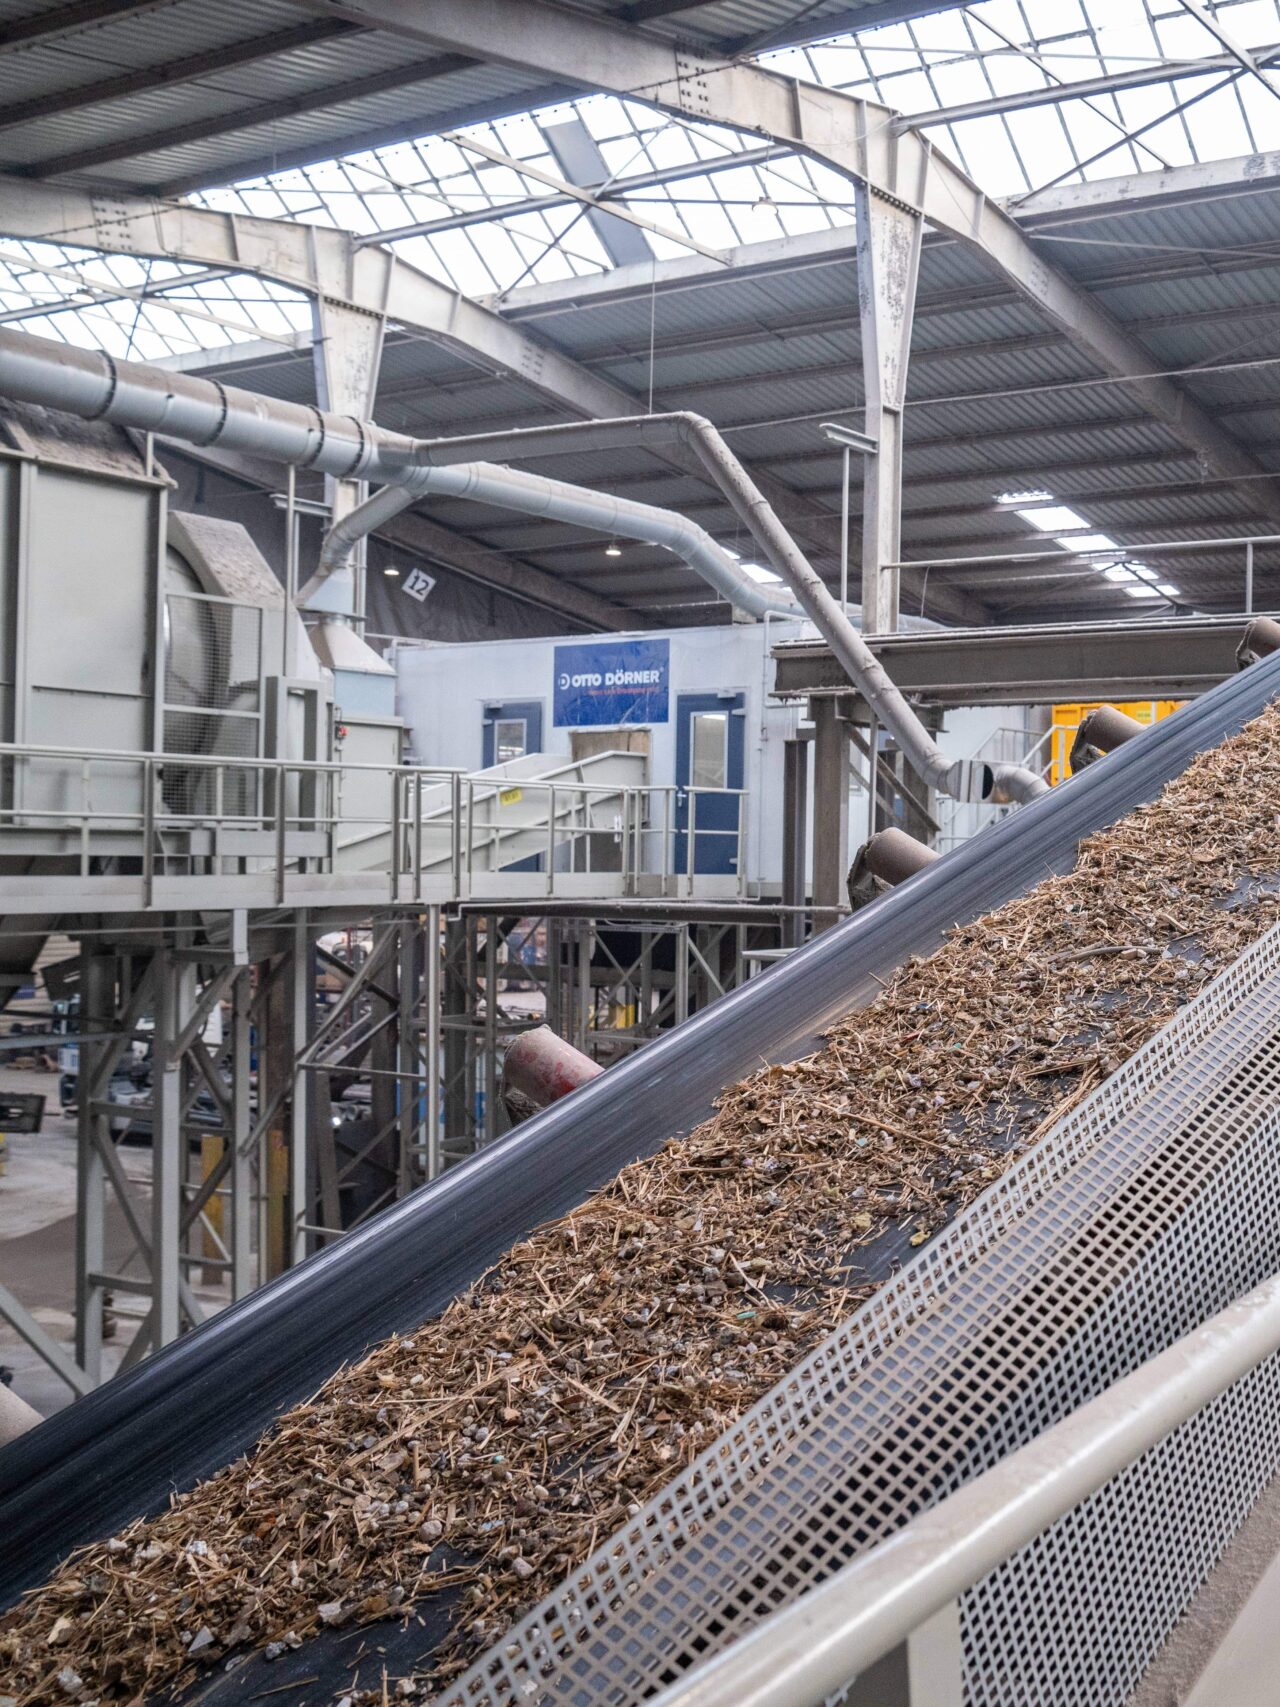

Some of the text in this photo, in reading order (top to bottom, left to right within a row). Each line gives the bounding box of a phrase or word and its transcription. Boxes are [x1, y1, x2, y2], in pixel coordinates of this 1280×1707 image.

[408, 576, 429, 596] 12
[571, 668, 660, 688] OTTO DÖRNER
